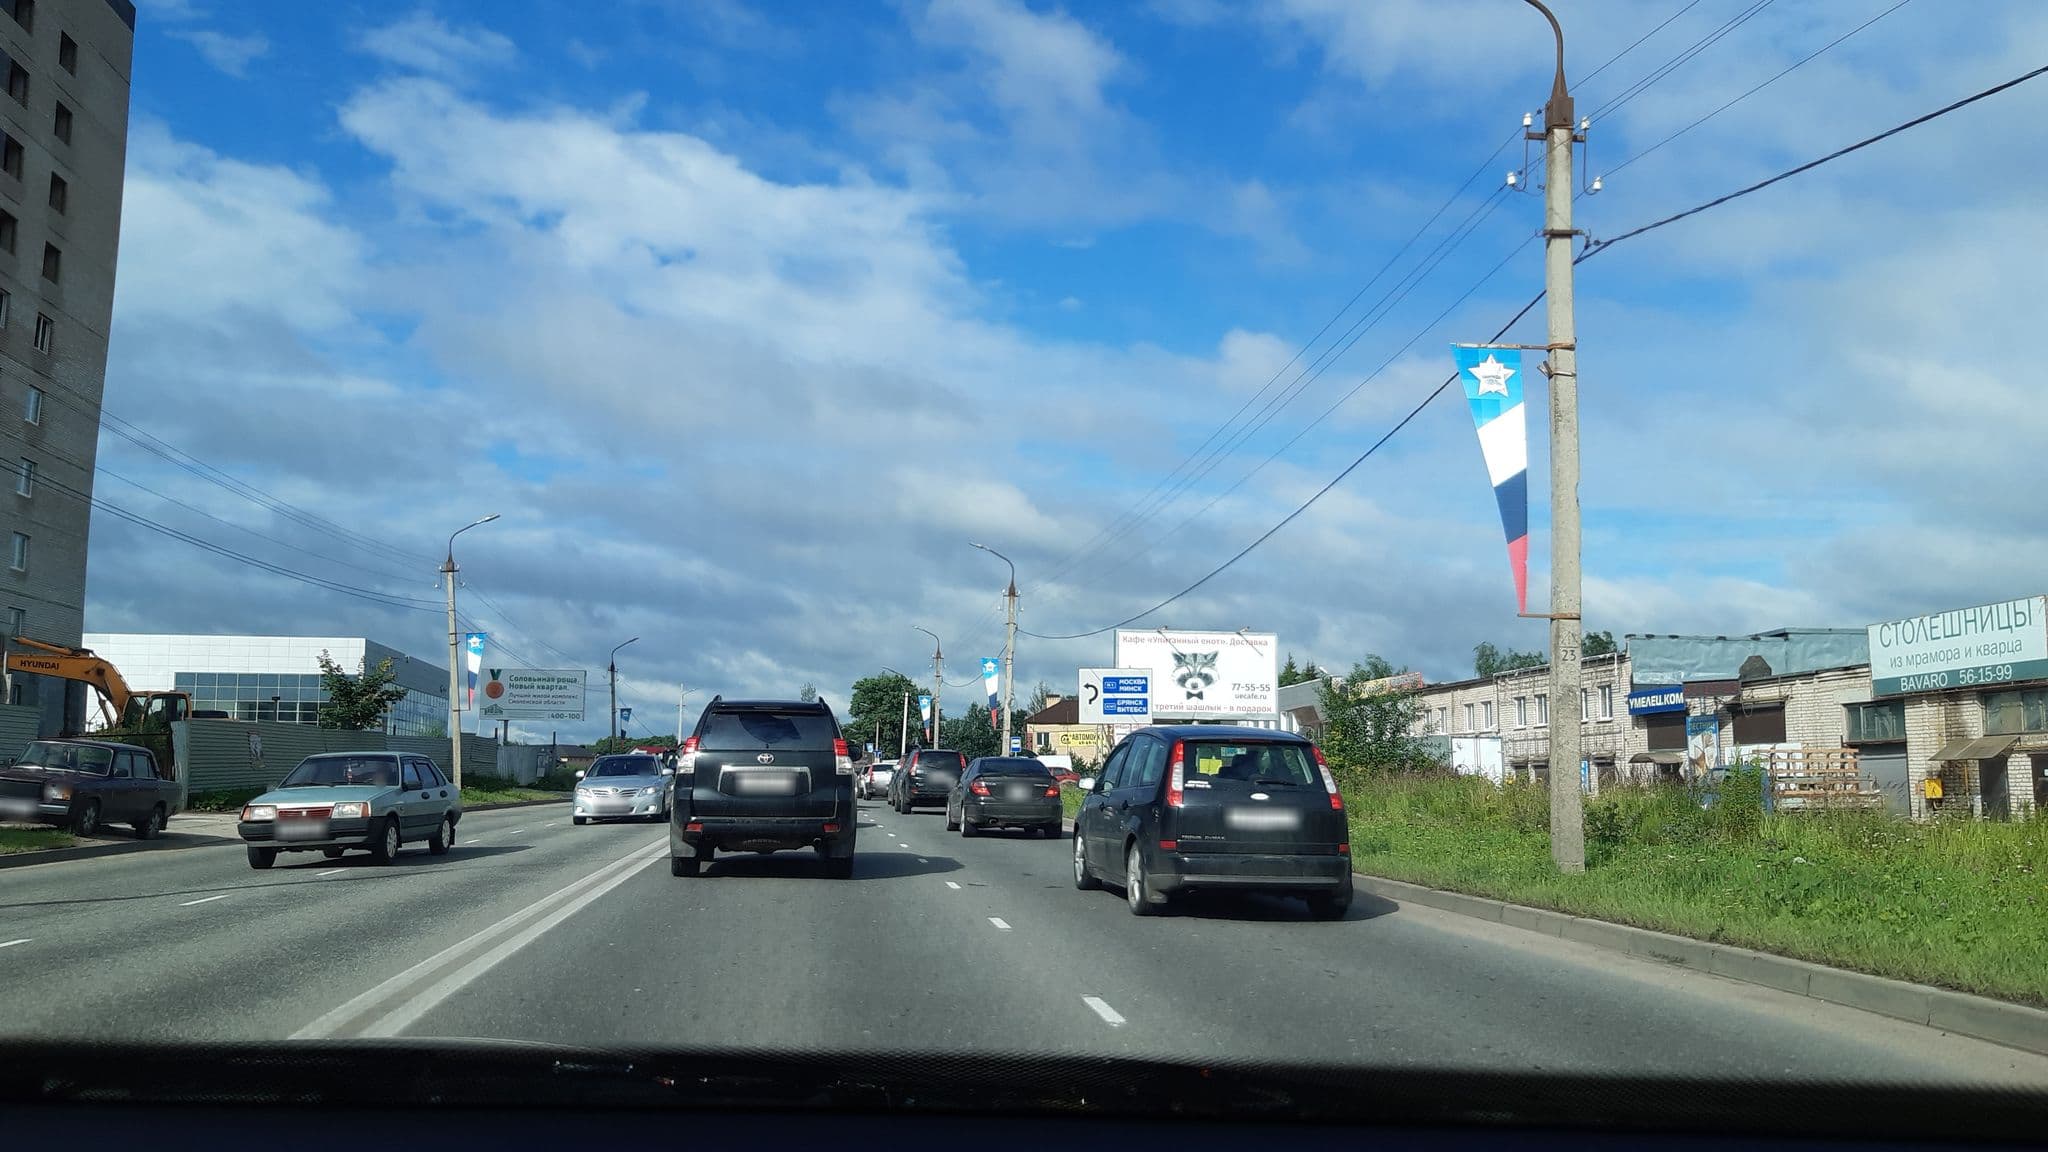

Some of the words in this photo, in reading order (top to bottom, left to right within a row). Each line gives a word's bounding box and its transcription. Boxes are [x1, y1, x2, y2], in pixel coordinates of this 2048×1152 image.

[1879, 599, 2032, 648] СТОЛЕШНИЦЫ
[1122, 636, 1145, 644] Кафе
[1229, 638, 1268, 647] Доставка
[1561, 649, 1577, 661] 23
[1890, 657, 1903, 668] из
[1906, 647, 1960, 668] мрамора
[1964, 647, 1972, 658] и
[1976, 639, 2022, 657] кварца
[20, 660, 60, 670] HYUNDAI
[509, 674, 555, 682] Соловьиная
[1900, 672, 1948, 692] BAVARO
[1959, 664, 2012, 685] 56-15-99
[1231, 683, 1271, 692] 77-55-55
[1629, 692, 1684, 709] УМЕЛЕЦ.КОМ
[1155, 703, 1185, 711] третий
[1186, 703, 1222, 711] шашлык
